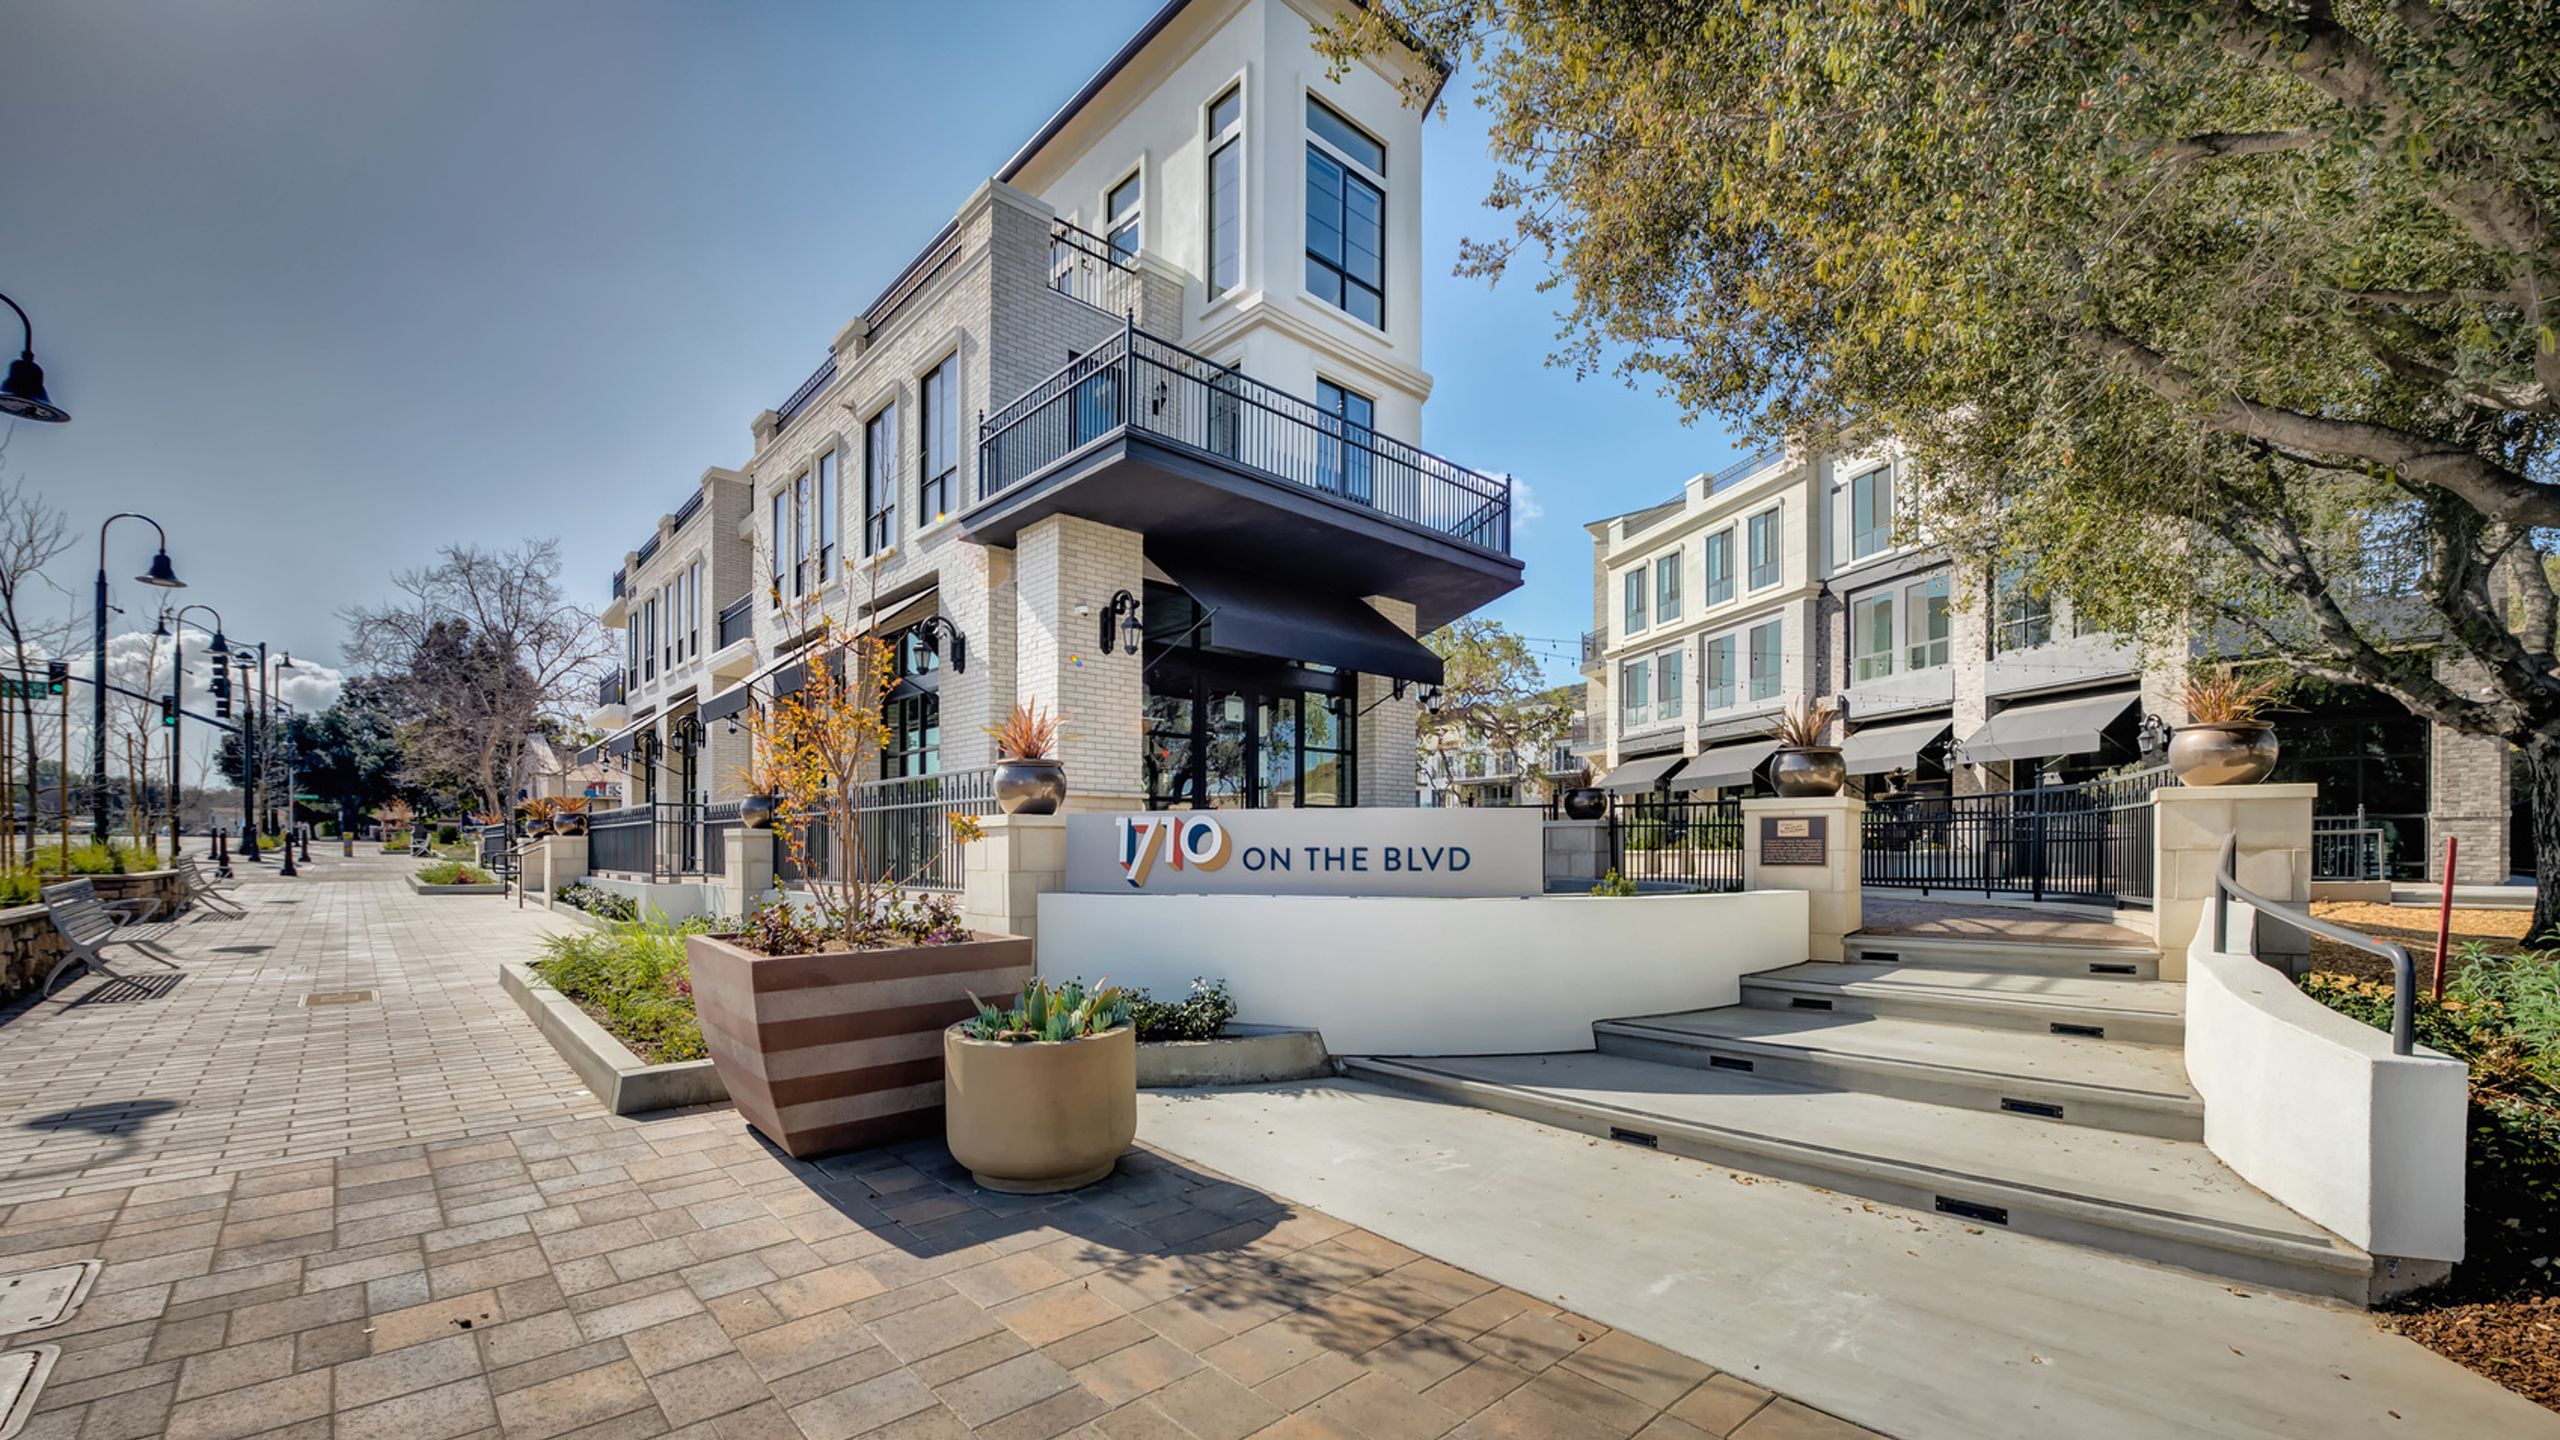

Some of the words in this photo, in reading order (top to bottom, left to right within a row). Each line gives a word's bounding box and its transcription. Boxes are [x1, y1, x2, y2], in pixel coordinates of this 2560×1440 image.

[1115, 815, 1231, 887] 1710
[1243, 847, 1290, 871] ON
[1304, 847, 1368, 871] THE
[1384, 847, 1470, 871] BLVD
